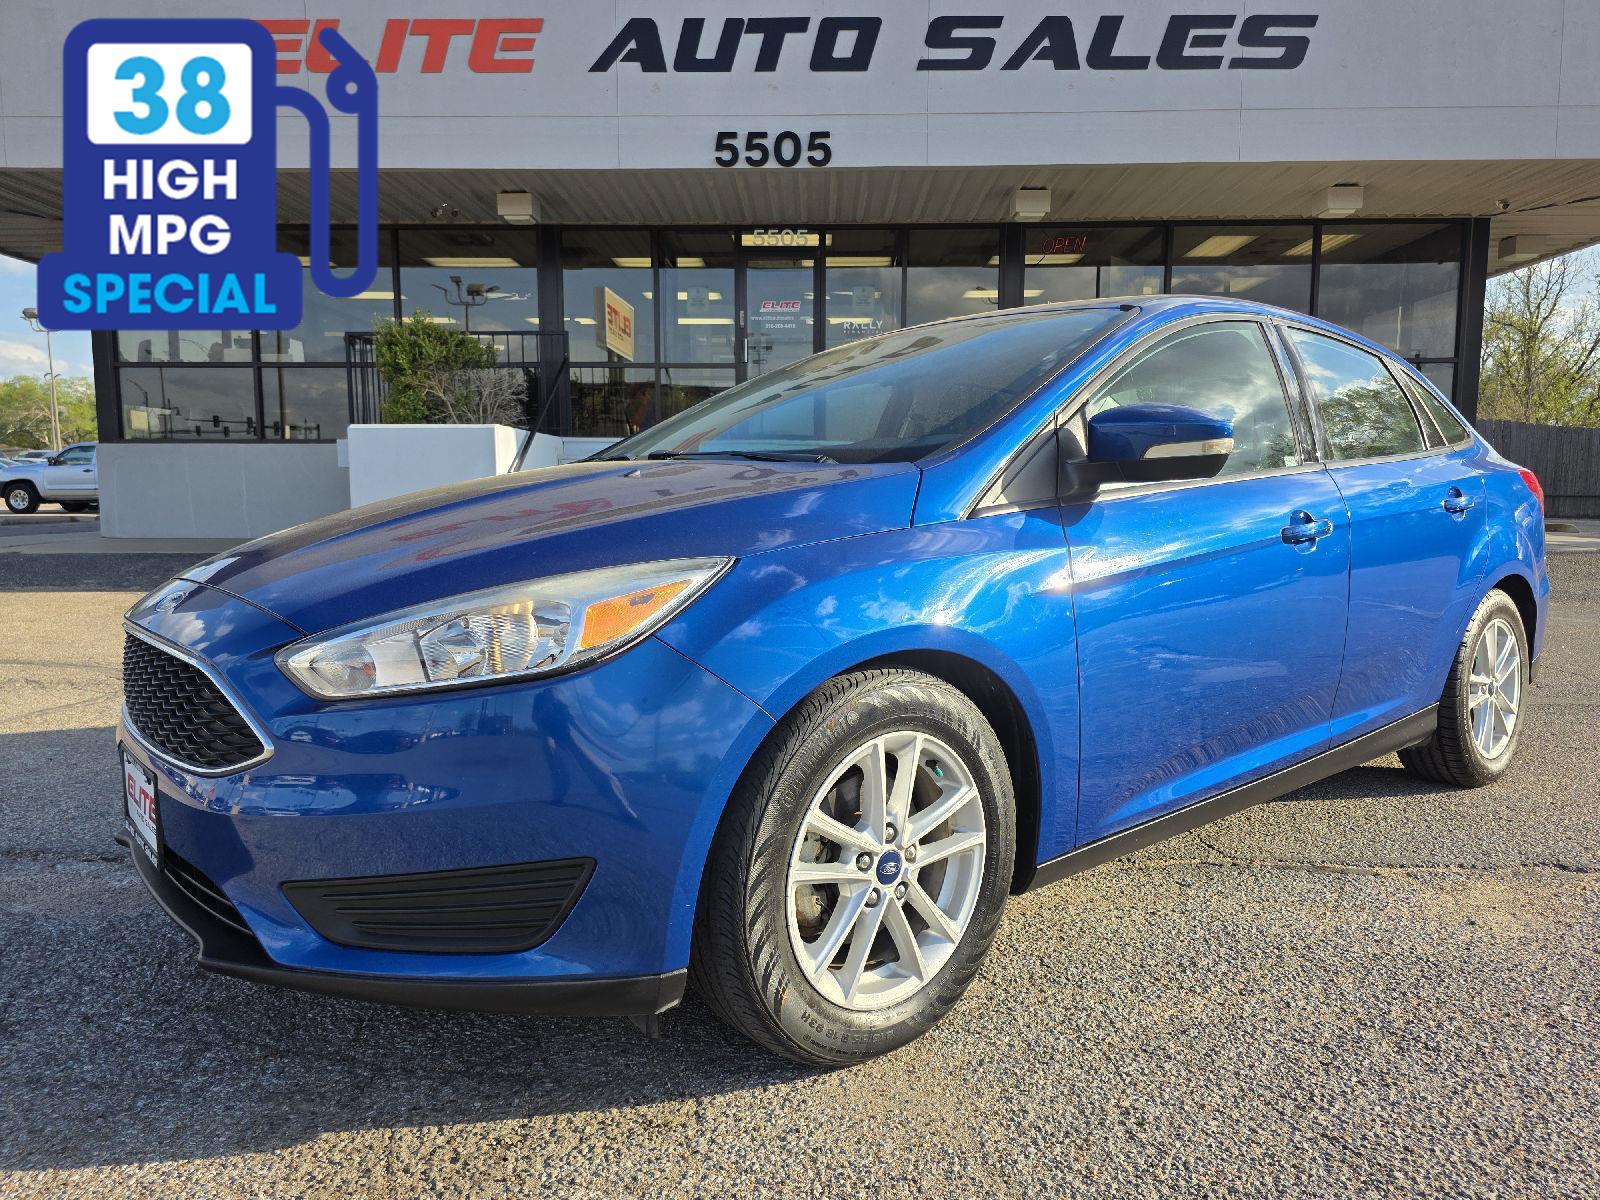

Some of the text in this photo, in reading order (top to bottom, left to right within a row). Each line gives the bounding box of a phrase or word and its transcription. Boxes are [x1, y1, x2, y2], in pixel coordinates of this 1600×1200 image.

[256, 14, 1319, 74] ELITE AUTO SALES
[714, 130, 833, 169] 5505
[753, 229, 808, 247] 5505
[1042, 235, 1087, 254] OPEN
[843, 320, 883, 330] RALLY
[127, 772, 156, 825] ELITE
